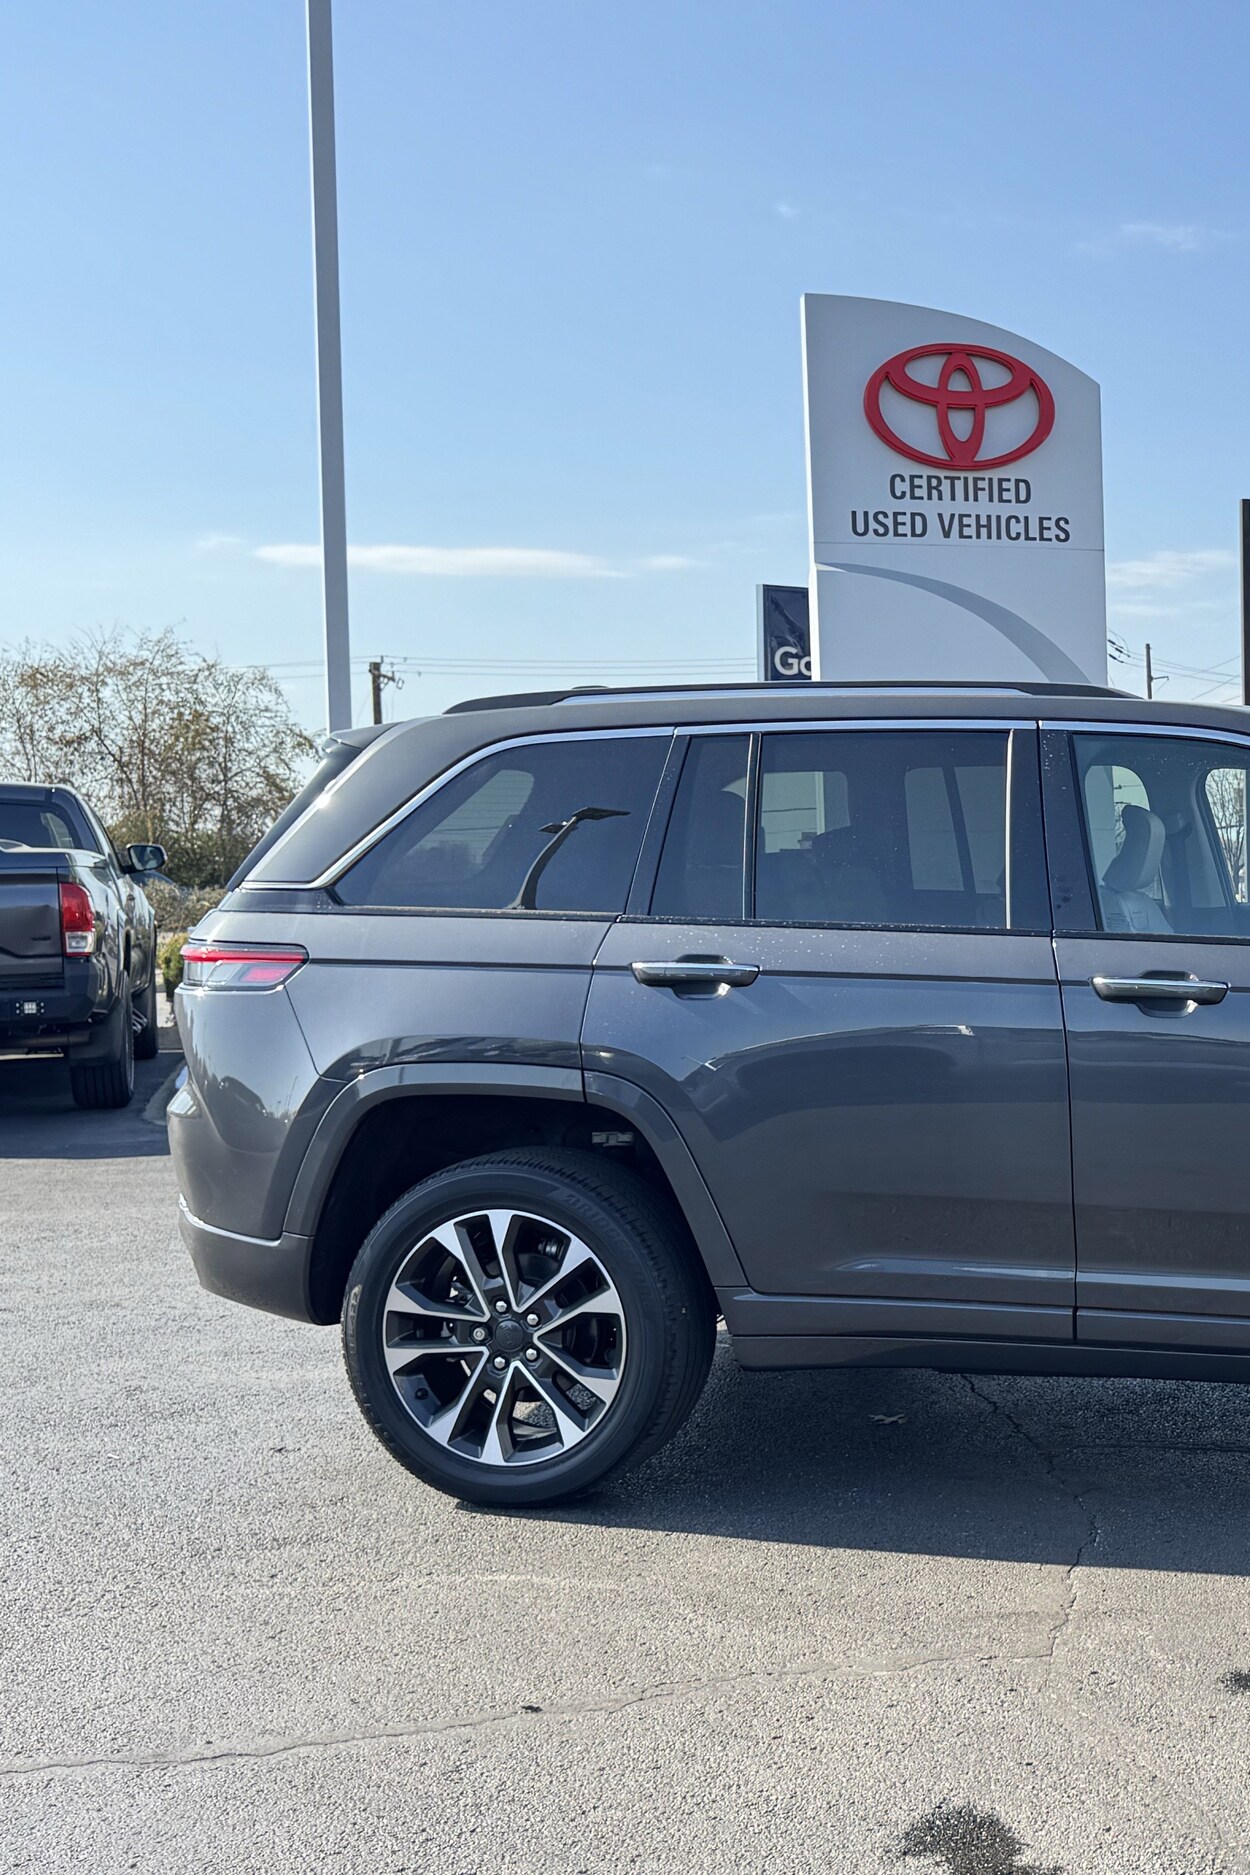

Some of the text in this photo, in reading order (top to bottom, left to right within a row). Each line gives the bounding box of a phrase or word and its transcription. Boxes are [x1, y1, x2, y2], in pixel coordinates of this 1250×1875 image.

[889, 473, 1032, 504] CERTIFIED
[851, 511, 1071, 543] USED VEHICLES
